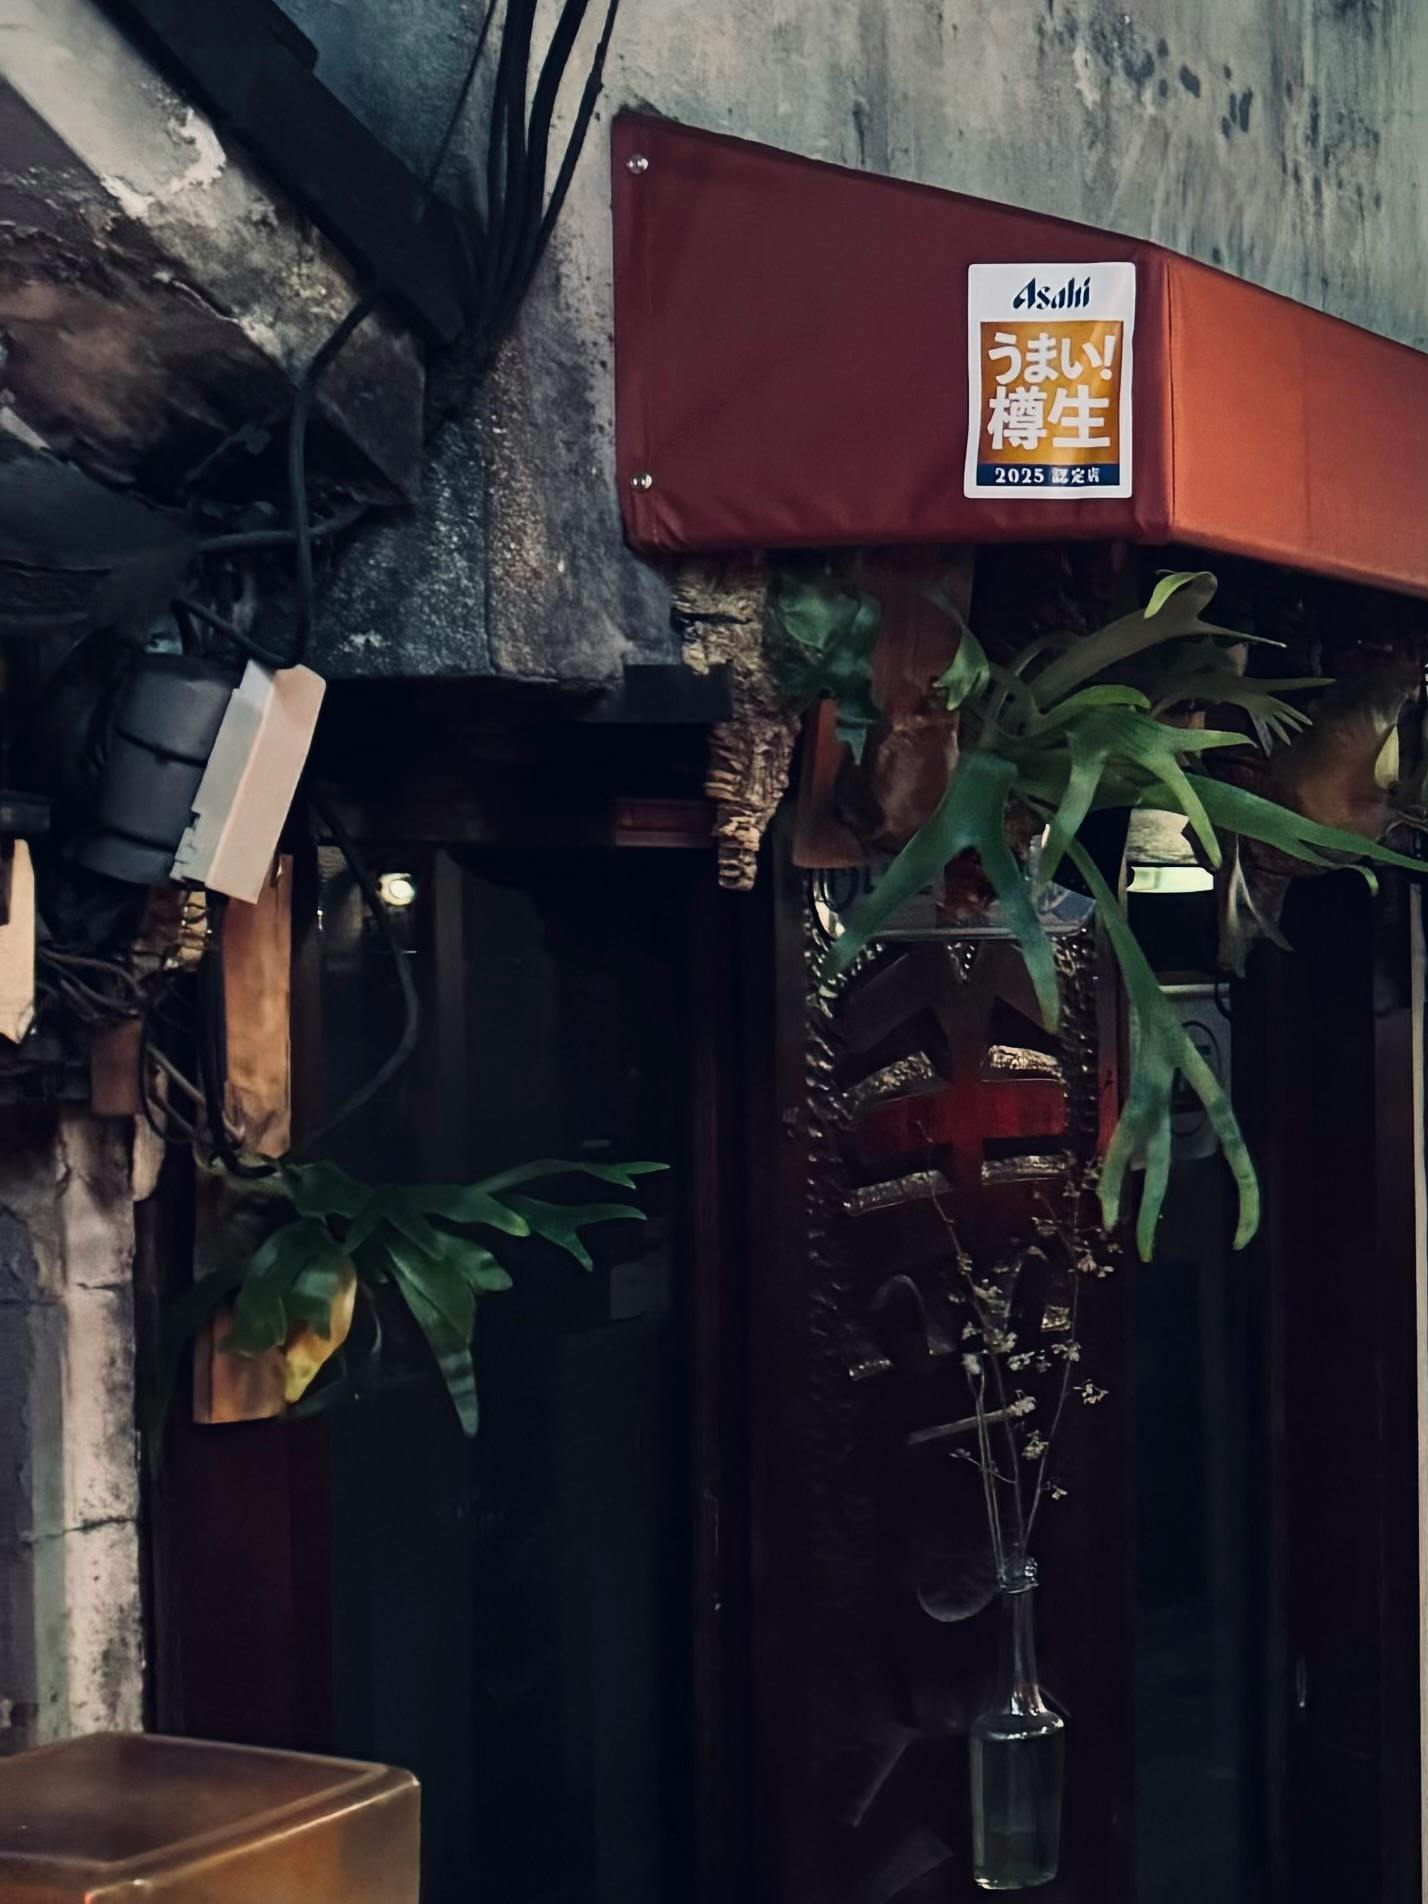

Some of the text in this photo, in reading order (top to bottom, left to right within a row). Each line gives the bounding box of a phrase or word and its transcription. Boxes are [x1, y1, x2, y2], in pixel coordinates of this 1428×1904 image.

[1012, 276, 1091, 310] Asahi
[987, 385, 1111, 450] 樽生
[994, 466, 1045, 485] 2025
